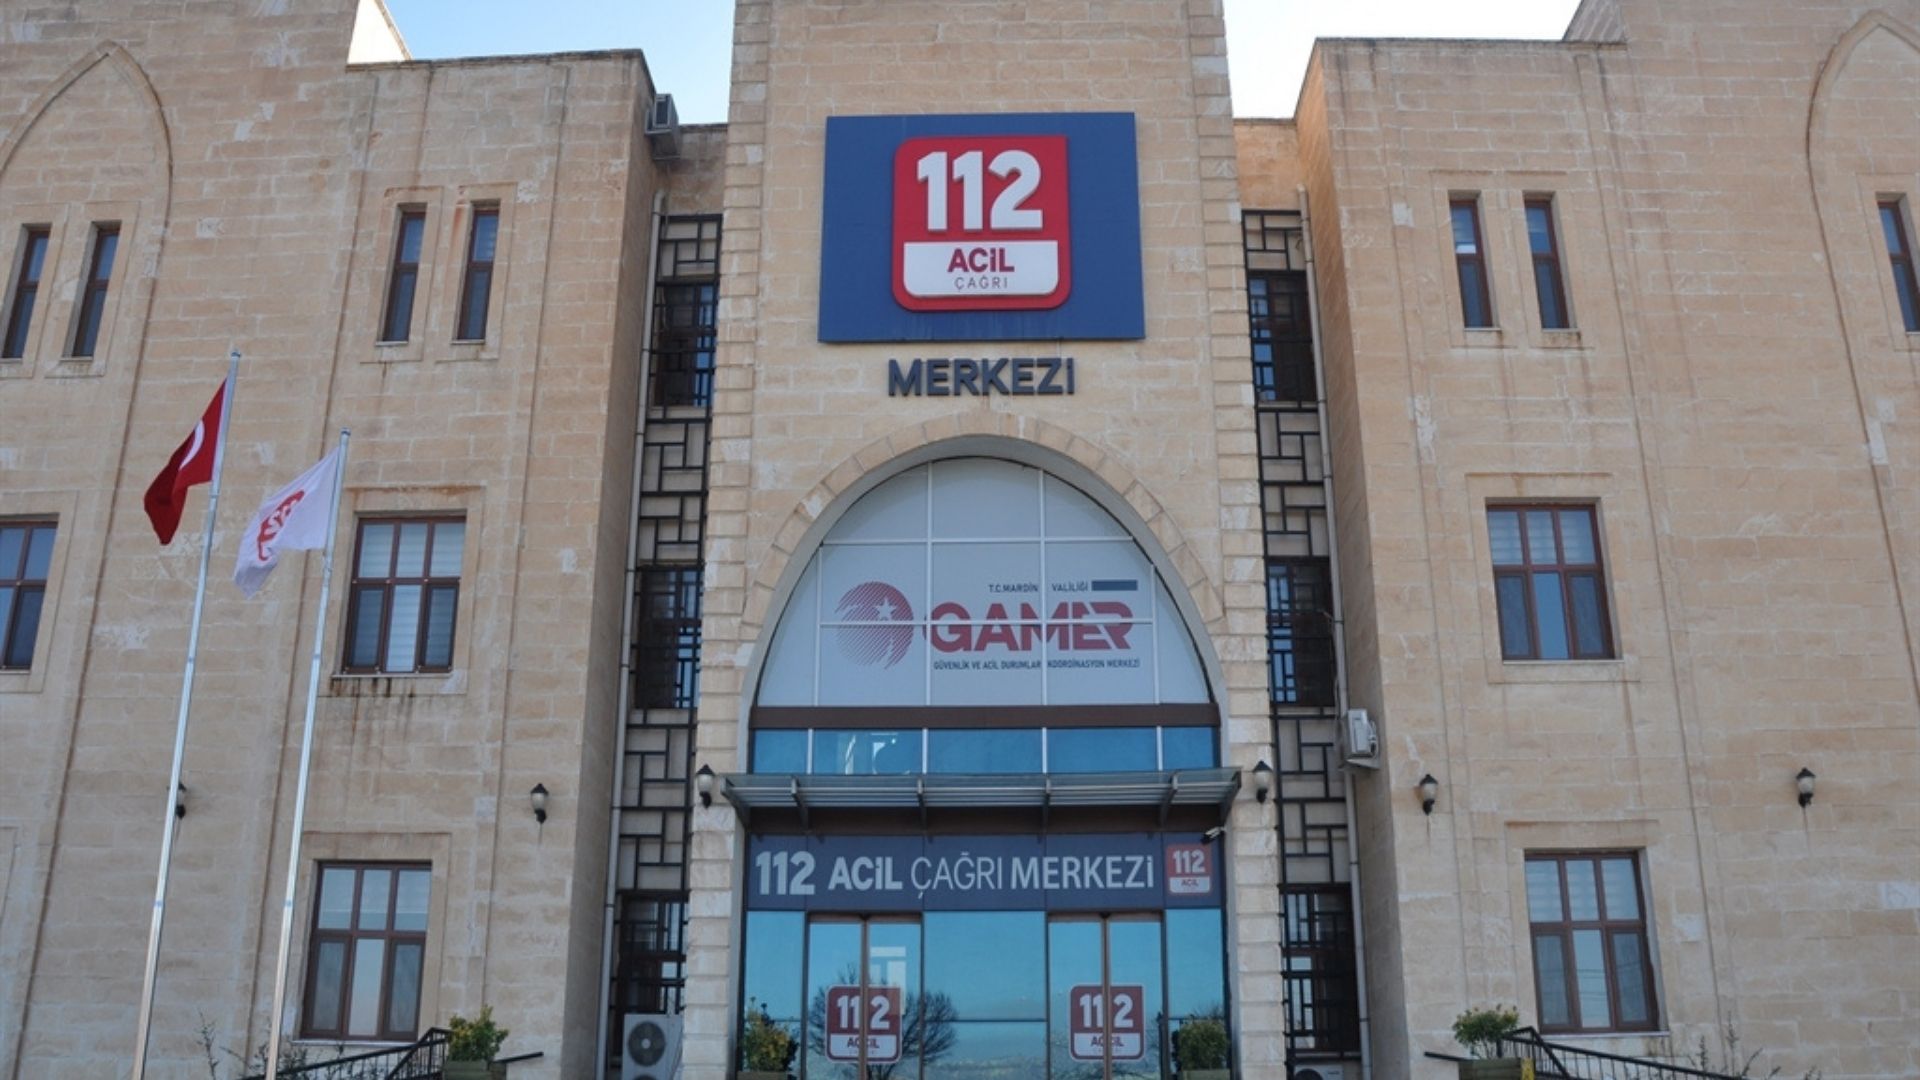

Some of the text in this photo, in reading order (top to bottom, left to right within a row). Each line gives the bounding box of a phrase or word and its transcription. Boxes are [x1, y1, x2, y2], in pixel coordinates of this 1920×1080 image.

[917, 150, 1043, 231] 112
[954, 276, 1008, 291] ÇAĞRI
[923, 601, 1134, 653] GAMER
[755, 851, 816, 895] 112
[911, 852, 1002, 899] ÇAĞRI
[1172, 850, 1205, 873] 112
[837, 995, 890, 1029] 112
[1080, 993, 1133, 1028] 112
